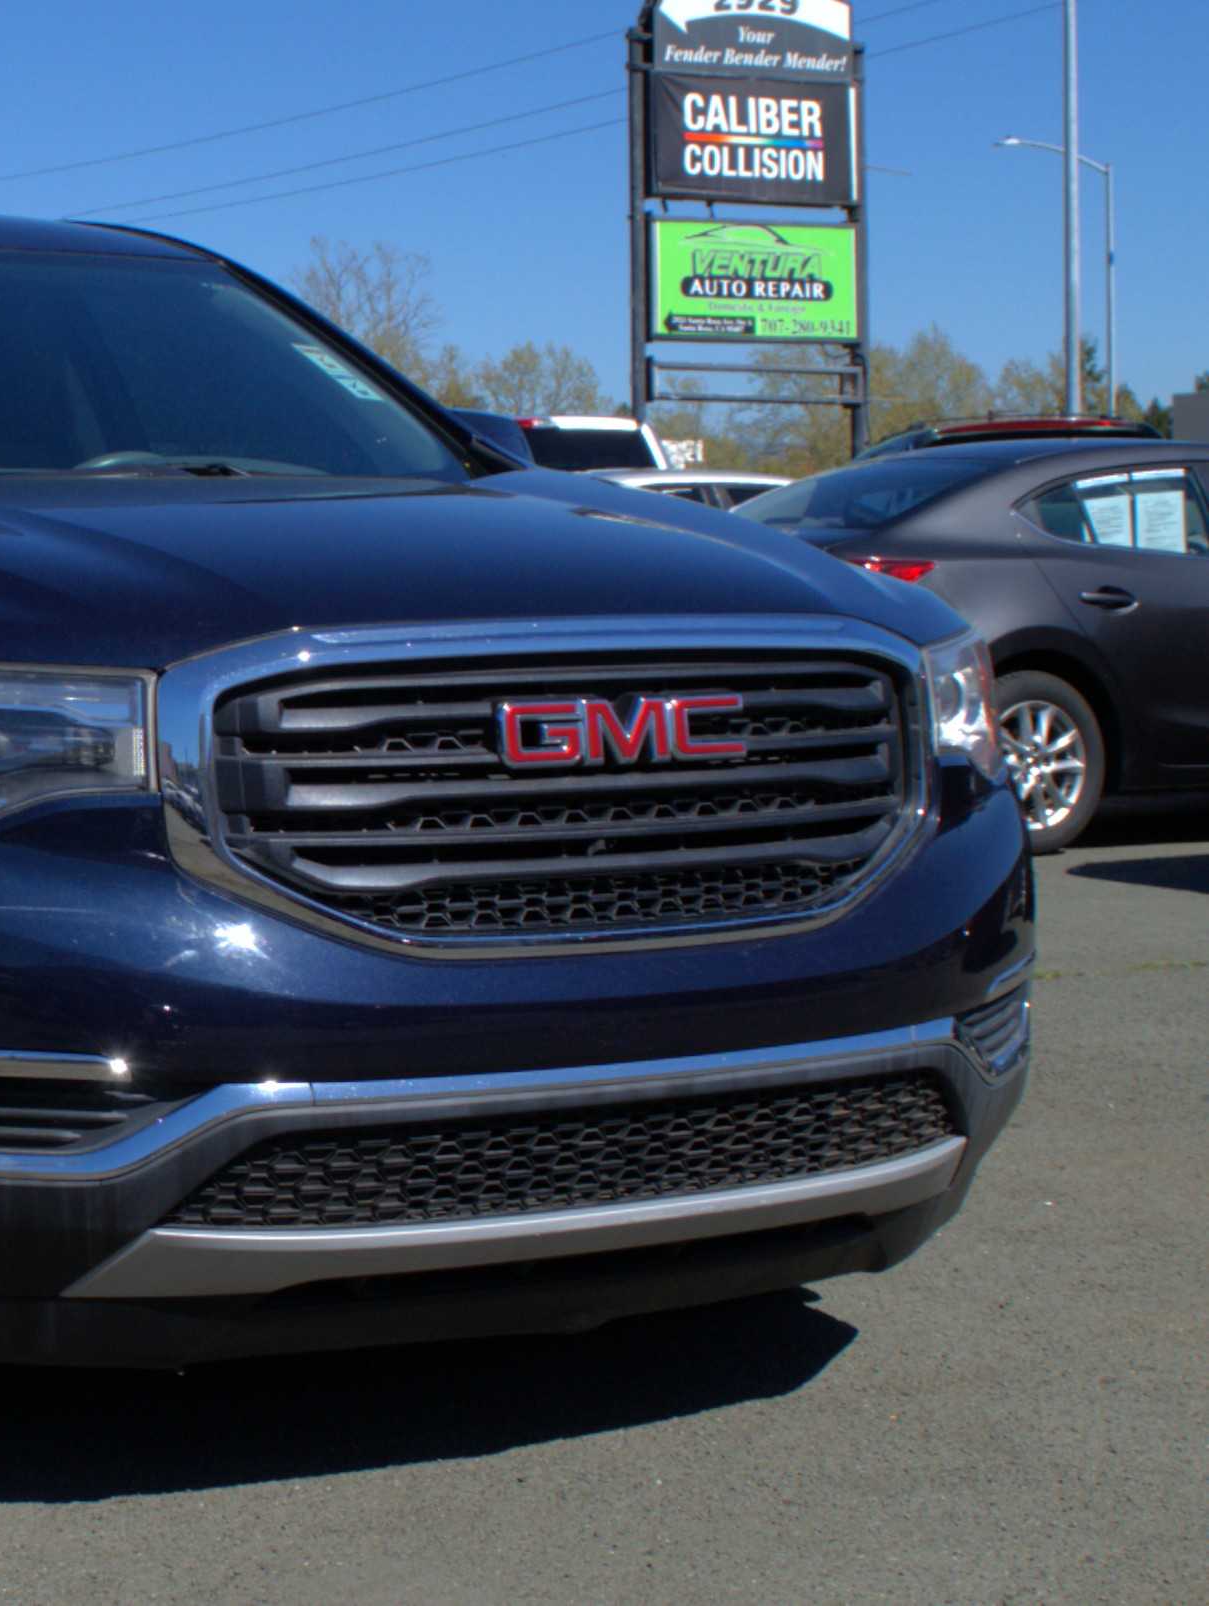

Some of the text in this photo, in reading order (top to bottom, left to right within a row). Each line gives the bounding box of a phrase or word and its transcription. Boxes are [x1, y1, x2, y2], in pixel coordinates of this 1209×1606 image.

[738, 25, 775, 45] Your
[664, 44, 847, 72] Fender Bender Mender!
[683, 92, 822, 137] CALIBER
[684, 143, 824, 181] COLLISION
[692, 250, 821, 278] VENTURA
[690, 278, 826, 299] AUTO REPAIR
[499, 694, 746, 768] GMC
